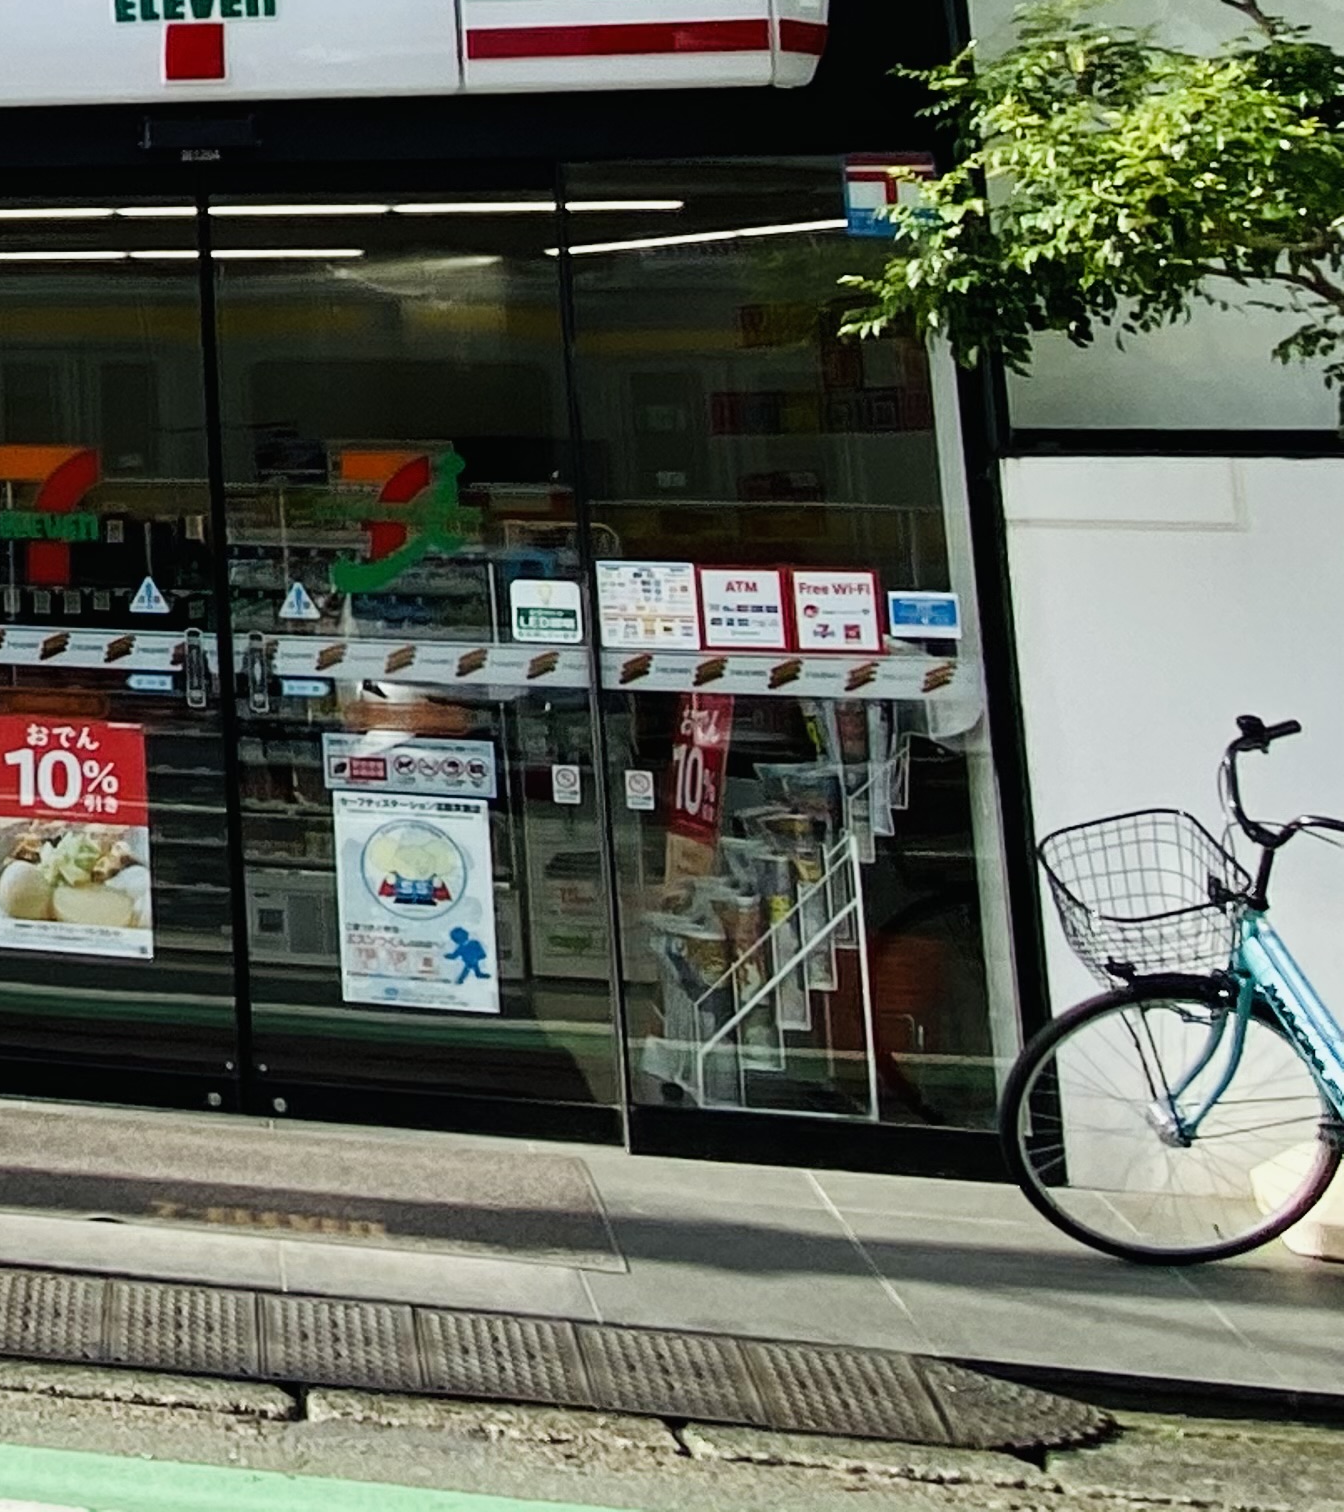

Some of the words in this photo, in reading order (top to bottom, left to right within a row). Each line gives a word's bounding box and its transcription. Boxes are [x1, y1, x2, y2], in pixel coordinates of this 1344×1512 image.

[725, 581, 758, 593] ATM
[798, 583, 829, 595] Free
[26, 723, 100, 750] おでん
